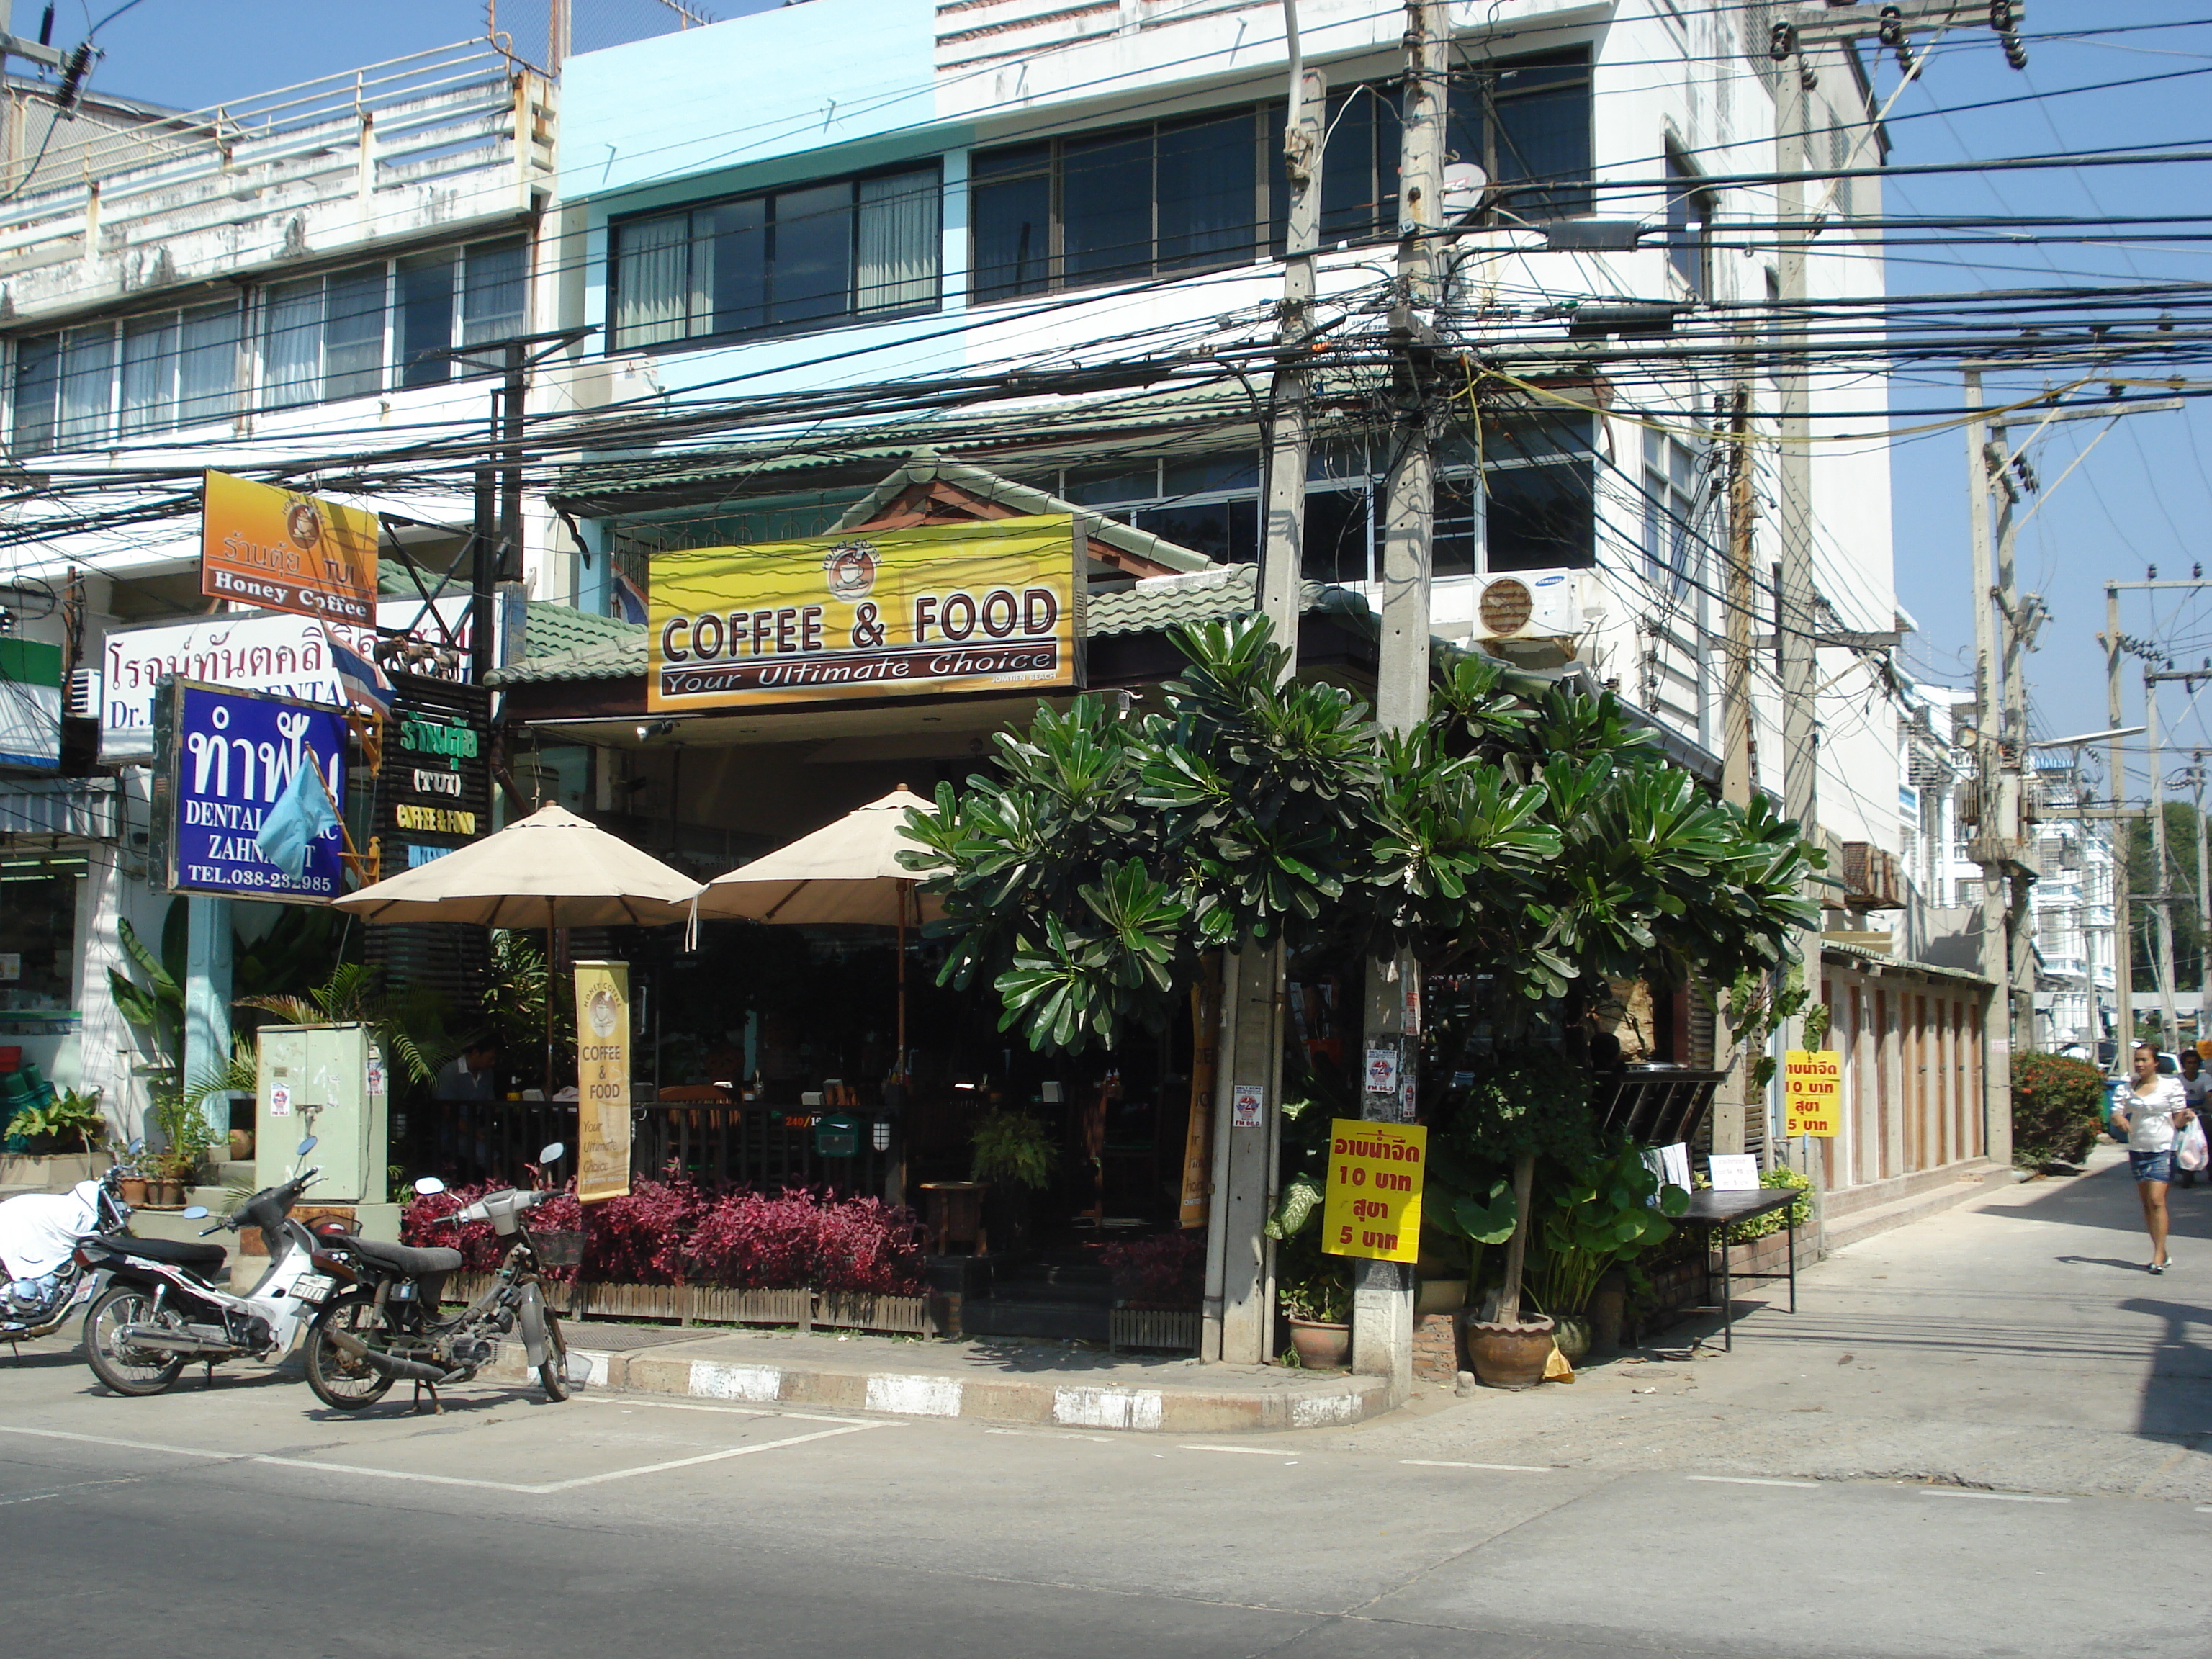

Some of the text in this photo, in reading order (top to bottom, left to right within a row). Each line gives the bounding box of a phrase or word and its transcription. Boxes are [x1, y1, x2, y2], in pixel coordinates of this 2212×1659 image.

[822, 539, 848, 570] HONEY
[323, 558, 354, 585] TUI
[215, 571, 367, 618] Honey Coffee
[662, 589, 1058, 662] COFFEE & FOOD
[666, 652, 1052, 693] Your Ultimate Choice
[413, 768, 462, 798] (TUI)
[208, 835, 315, 868] ZAHNT
[583, 983, 600, 1008] HONEY
[582, 1045, 621, 1061] COFFEE
[598, 1064, 607, 1080] &
[589, 1083, 620, 1100] FOOD
[1809, 1083, 1834, 1093] บาท
[583, 1120, 603, 1133] Your
[1788, 1118, 1828, 1131] 5 บาท
[1340, 1166, 1411, 1192] 10 บาท
[1353, 1198, 1388, 1222] สุขา
[1340, 1226, 1398, 1251] 5 บาท
